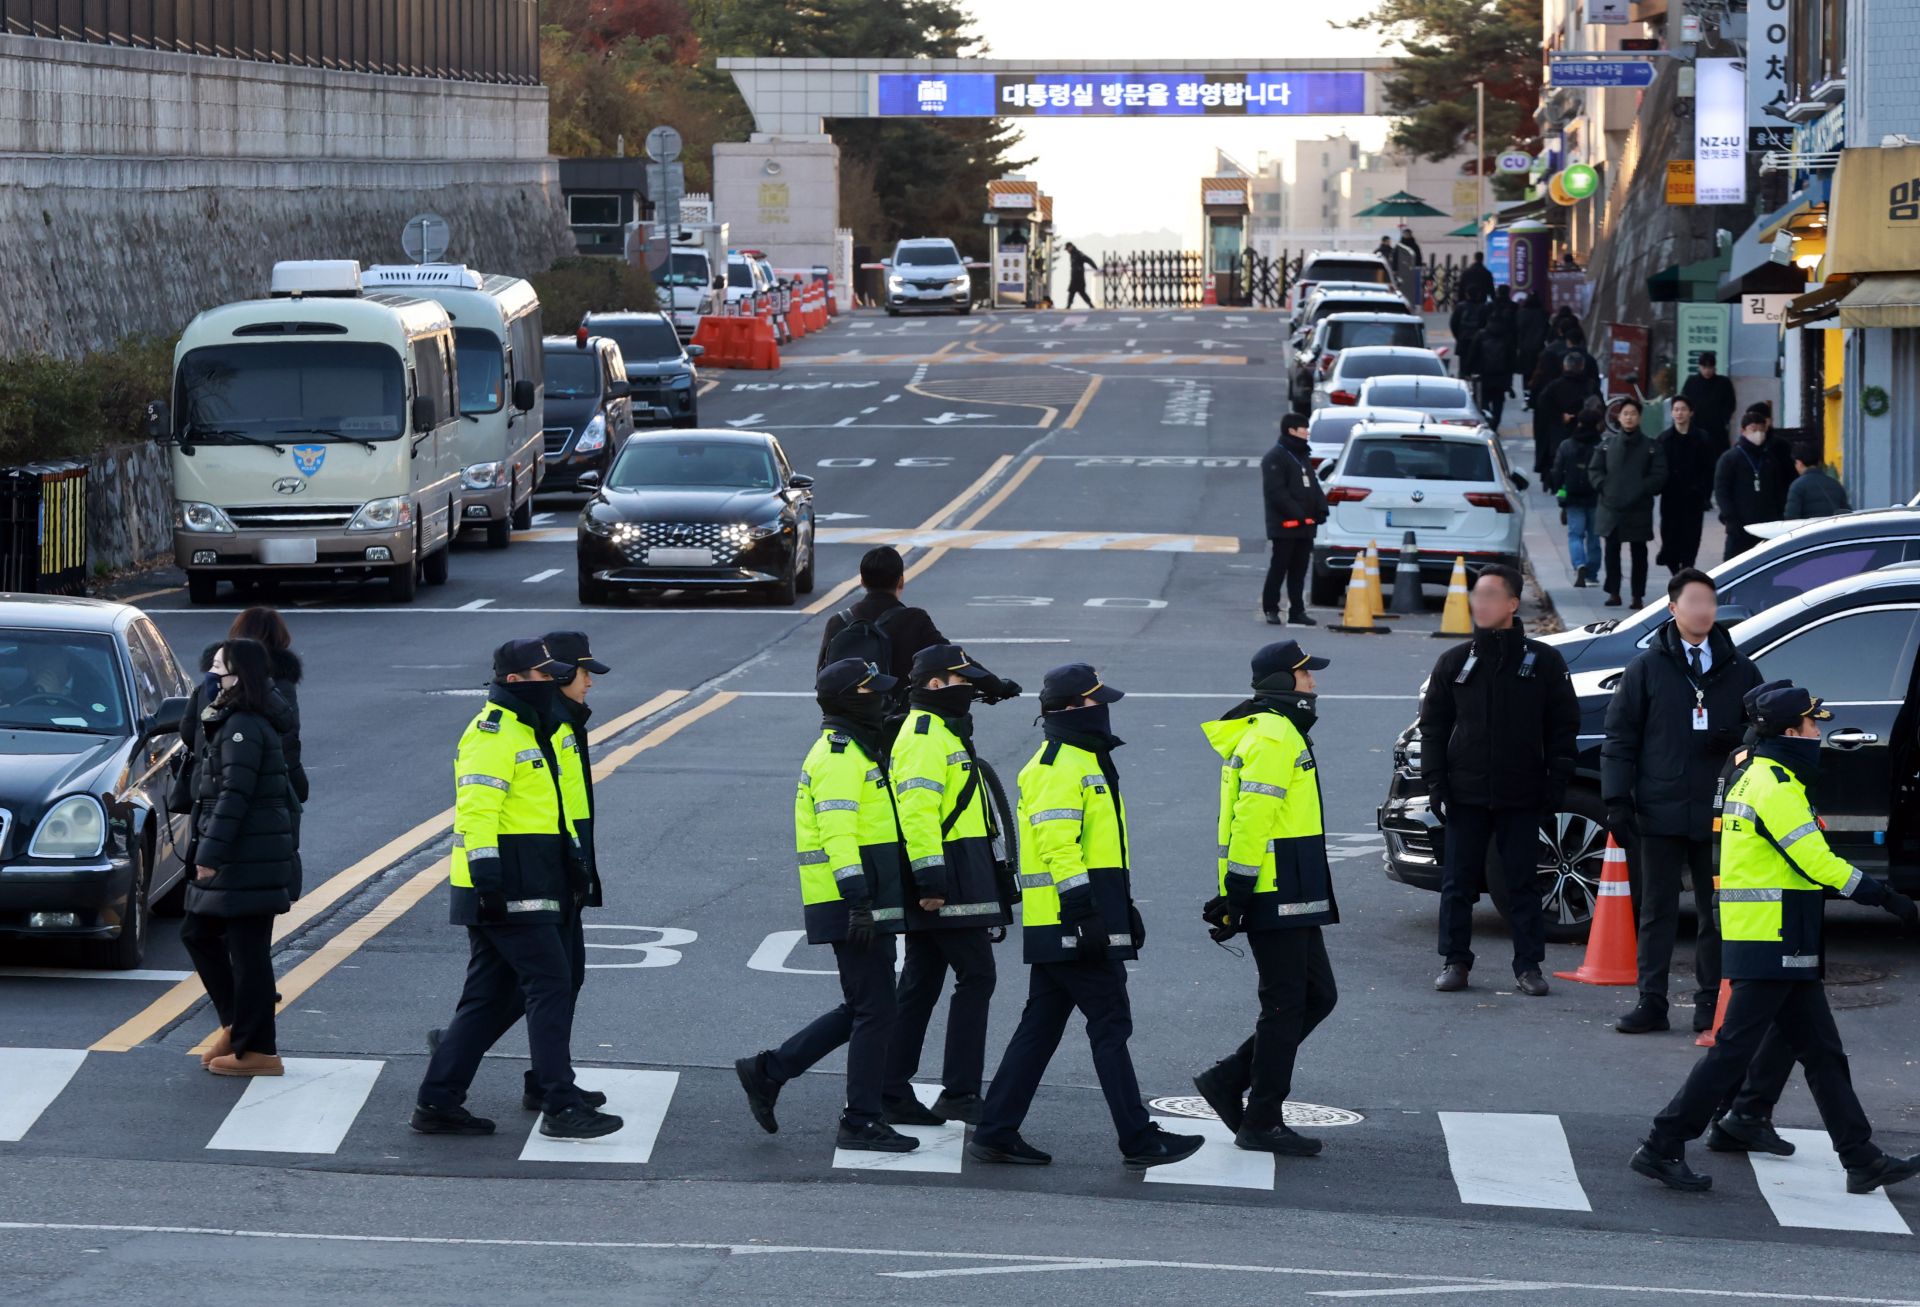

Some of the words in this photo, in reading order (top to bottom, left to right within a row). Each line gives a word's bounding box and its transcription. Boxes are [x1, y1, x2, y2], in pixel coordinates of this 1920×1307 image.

[1002, 83, 1093, 107] 대통령실
[1101, 83, 1169, 107] 방문을
[1176, 83, 1292, 106] 환영합니다
[1701, 136, 1740, 148] NZ4U
[1503, 157, 1526, 168] CU
[1750, 297, 1765, 314] 김
[966, 595, 1168, 609] 30
